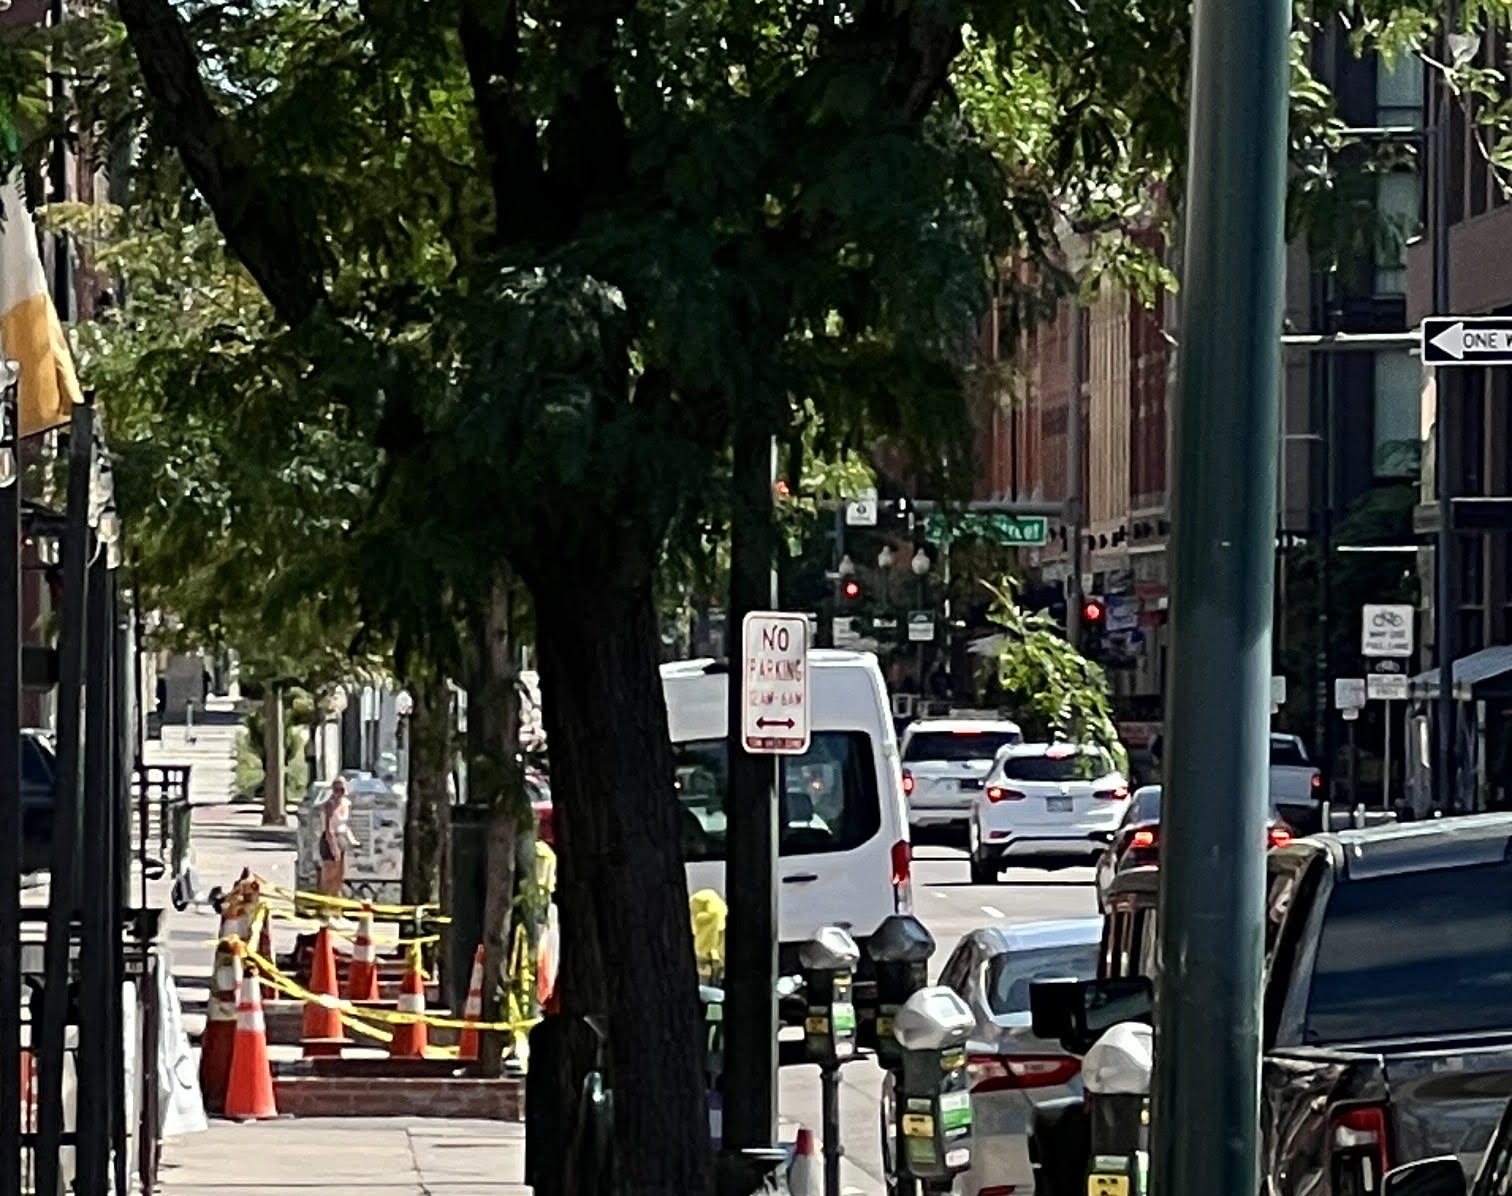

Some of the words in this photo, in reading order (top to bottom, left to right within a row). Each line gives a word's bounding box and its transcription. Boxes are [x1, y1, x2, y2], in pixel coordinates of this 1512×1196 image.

[1463, 333, 1498, 349] ONE
[762, 625, 790, 652] NO
[749, 658, 802, 682] PARKING
